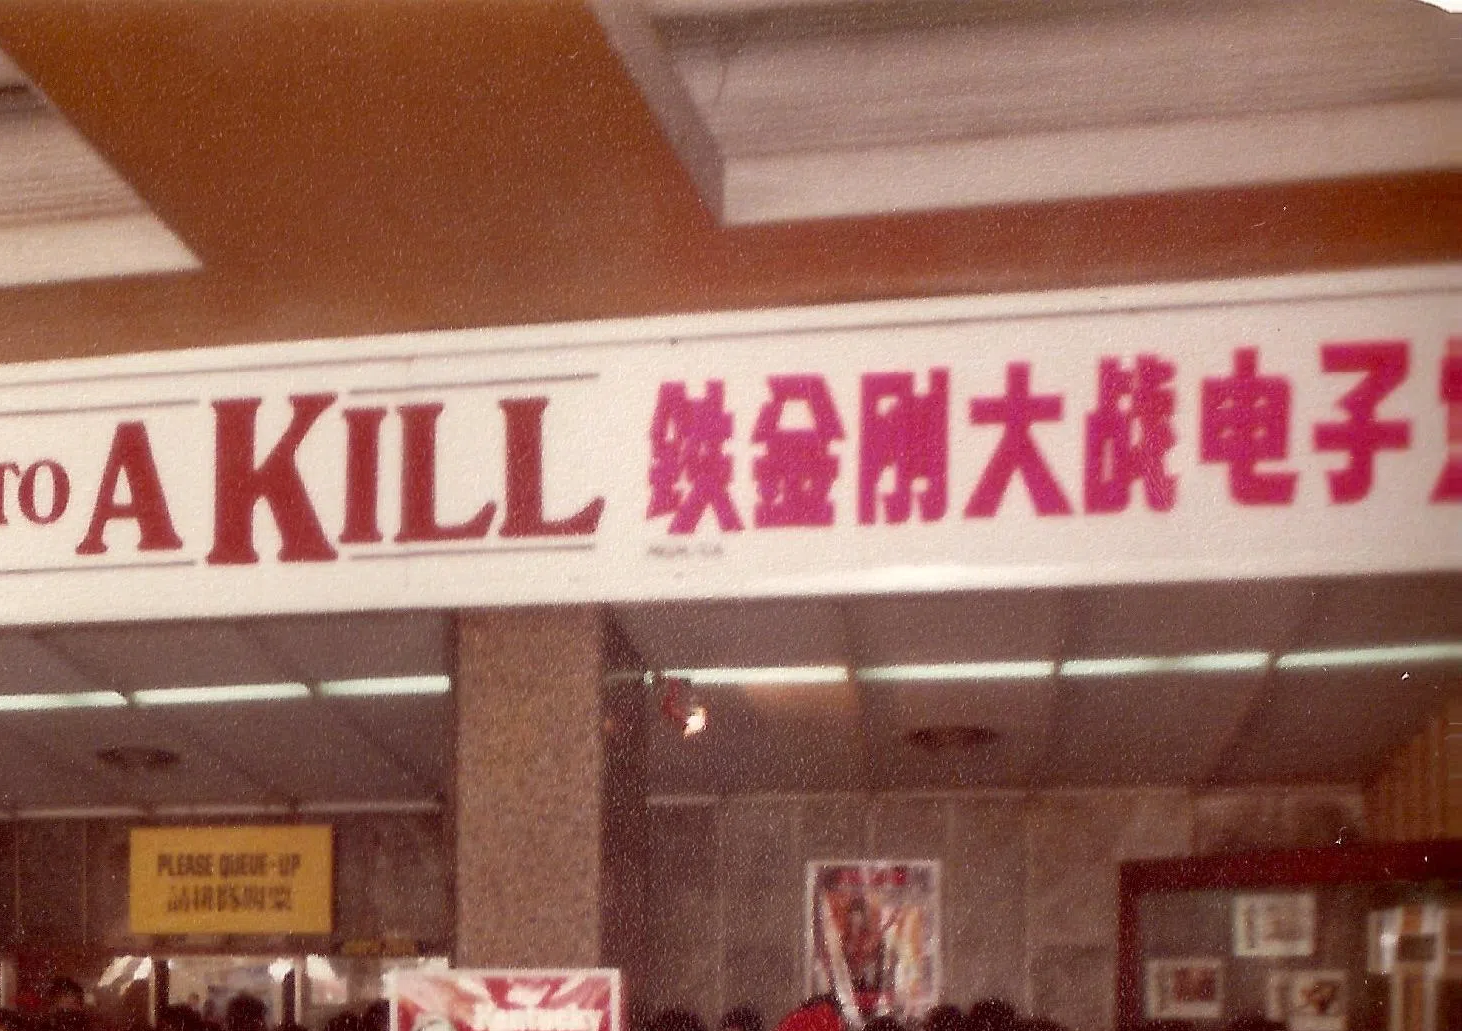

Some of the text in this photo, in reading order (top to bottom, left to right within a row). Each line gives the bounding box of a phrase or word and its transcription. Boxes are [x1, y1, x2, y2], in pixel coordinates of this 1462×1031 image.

[75, 421, 182, 555] A
[206, 392, 607, 565] KILL
[157, 852, 213, 877] PLEASE
